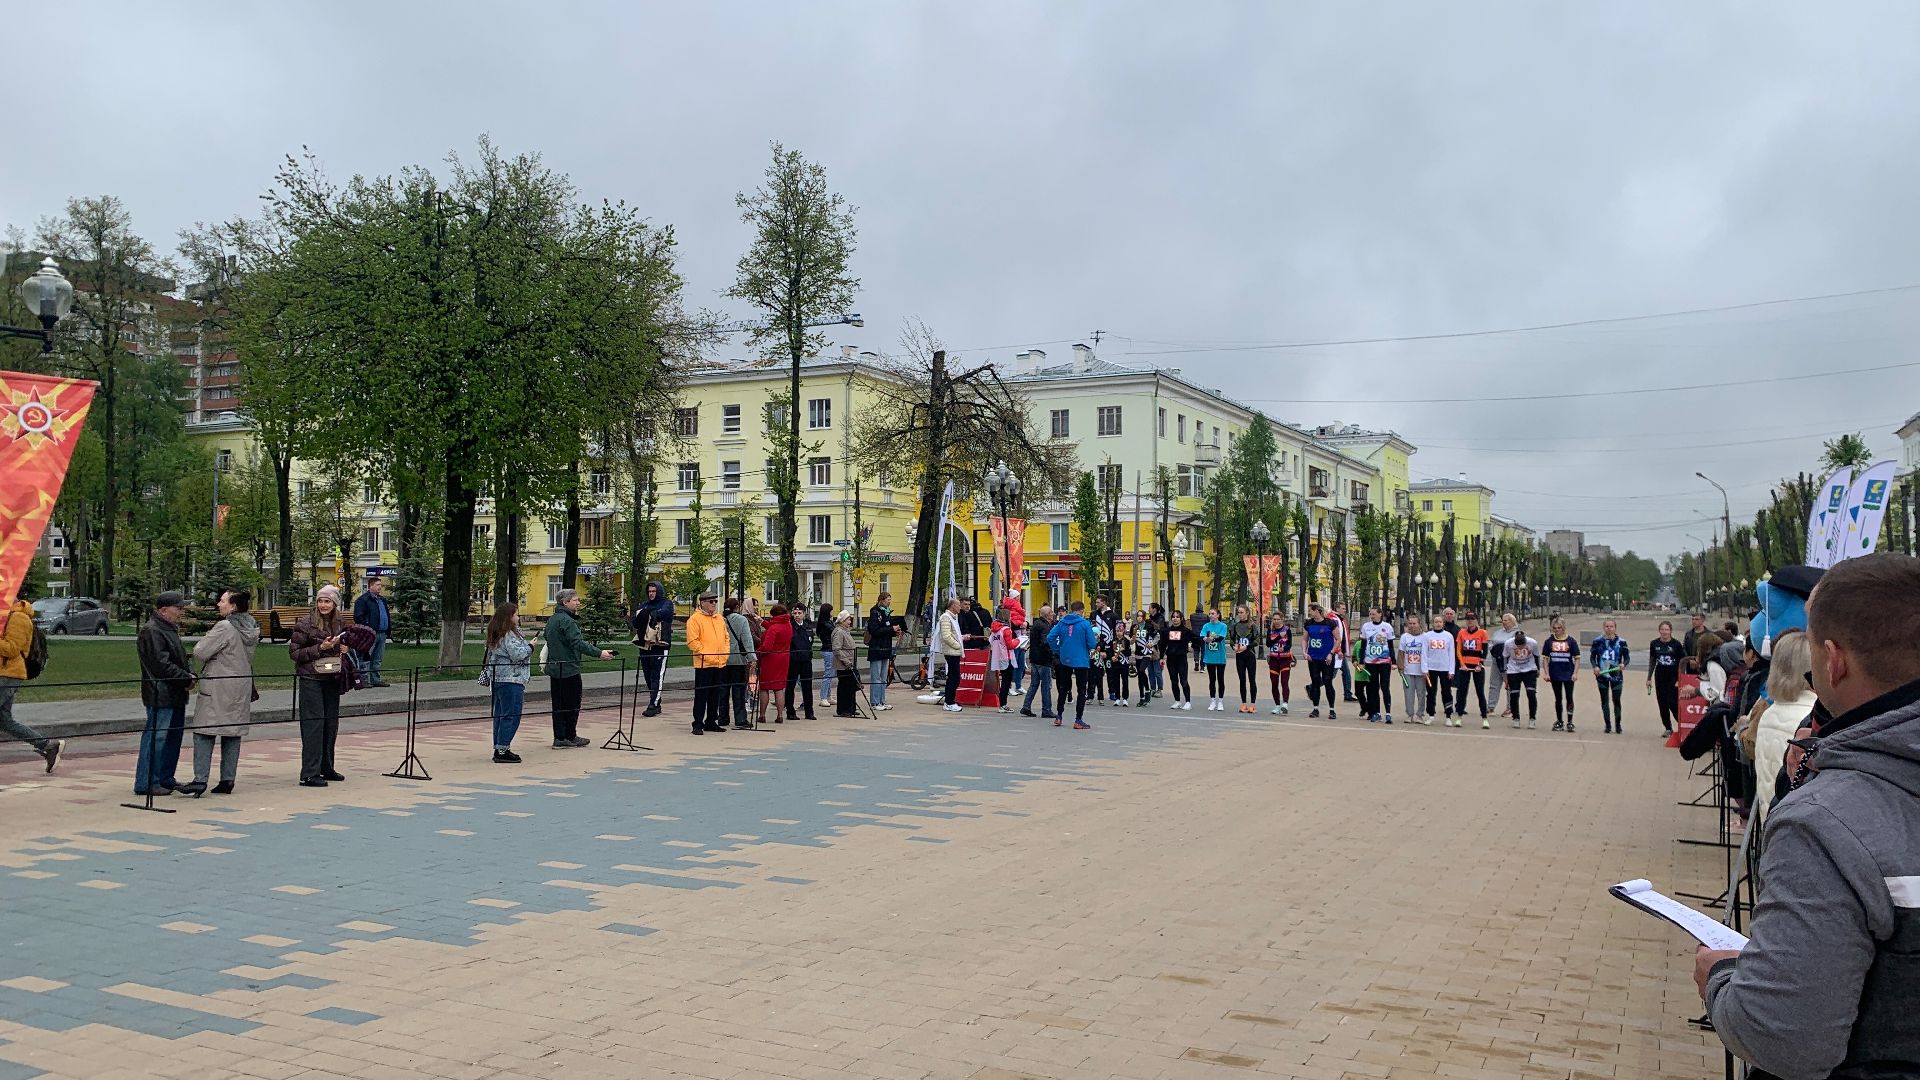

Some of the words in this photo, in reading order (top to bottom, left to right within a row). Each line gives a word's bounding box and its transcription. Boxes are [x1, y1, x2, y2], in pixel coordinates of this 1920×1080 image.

[1250, 558, 1257, 568] 9
[1170, 631, 1181, 640] 34
[1208, 642, 1218, 651] 62
[1311, 639, 1322, 648] 65
[1431, 640, 1444, 649] 33
[1464, 640, 1476, 649] 44
[1555, 641, 1566, 651] 31
[1371, 645, 1382, 655] 60
[1515, 648, 1528, 657] 30
[1408, 655, 1420, 663] 32
[1602, 650, 1615, 660] 41
[1660, 655, 1672, 665] 43
